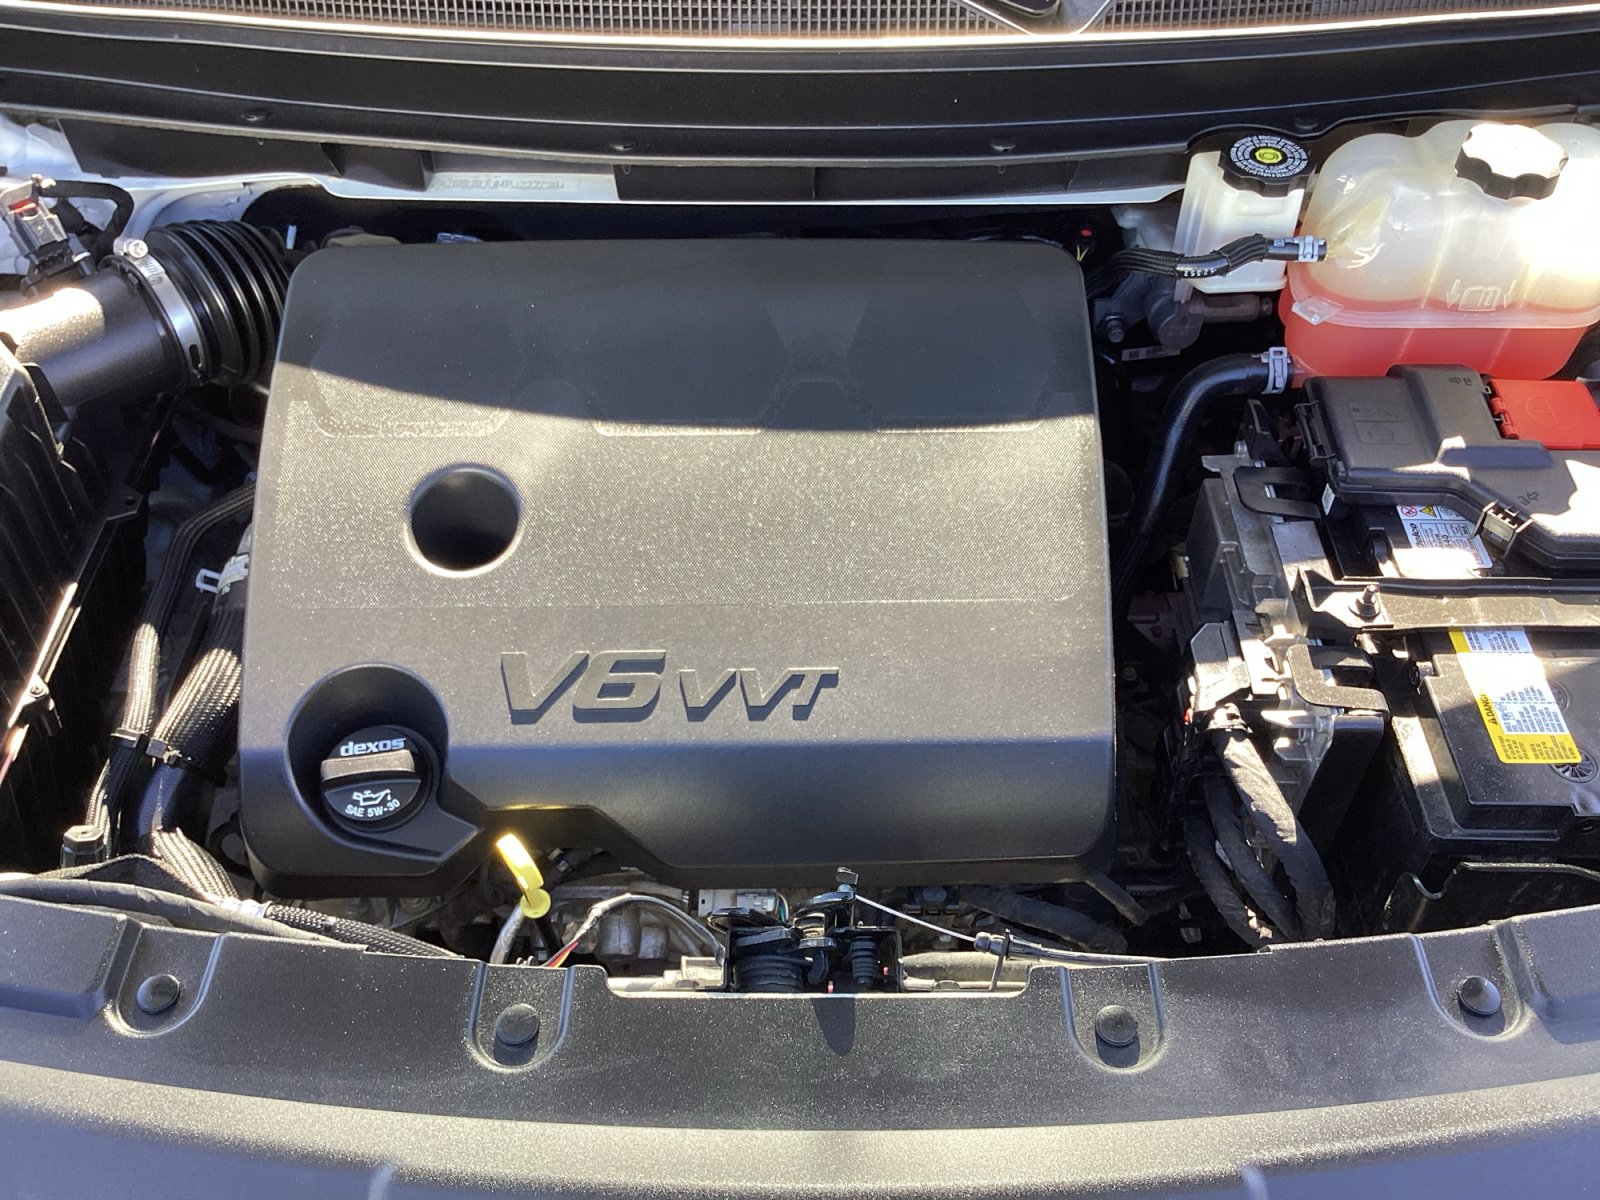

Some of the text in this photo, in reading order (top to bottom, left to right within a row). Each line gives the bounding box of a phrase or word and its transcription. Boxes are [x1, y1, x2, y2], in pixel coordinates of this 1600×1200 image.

[500, 649, 840, 725] V6 VVT
[340, 737, 407, 757] dexos
[345, 798, 401, 818] SAE 5W-30
